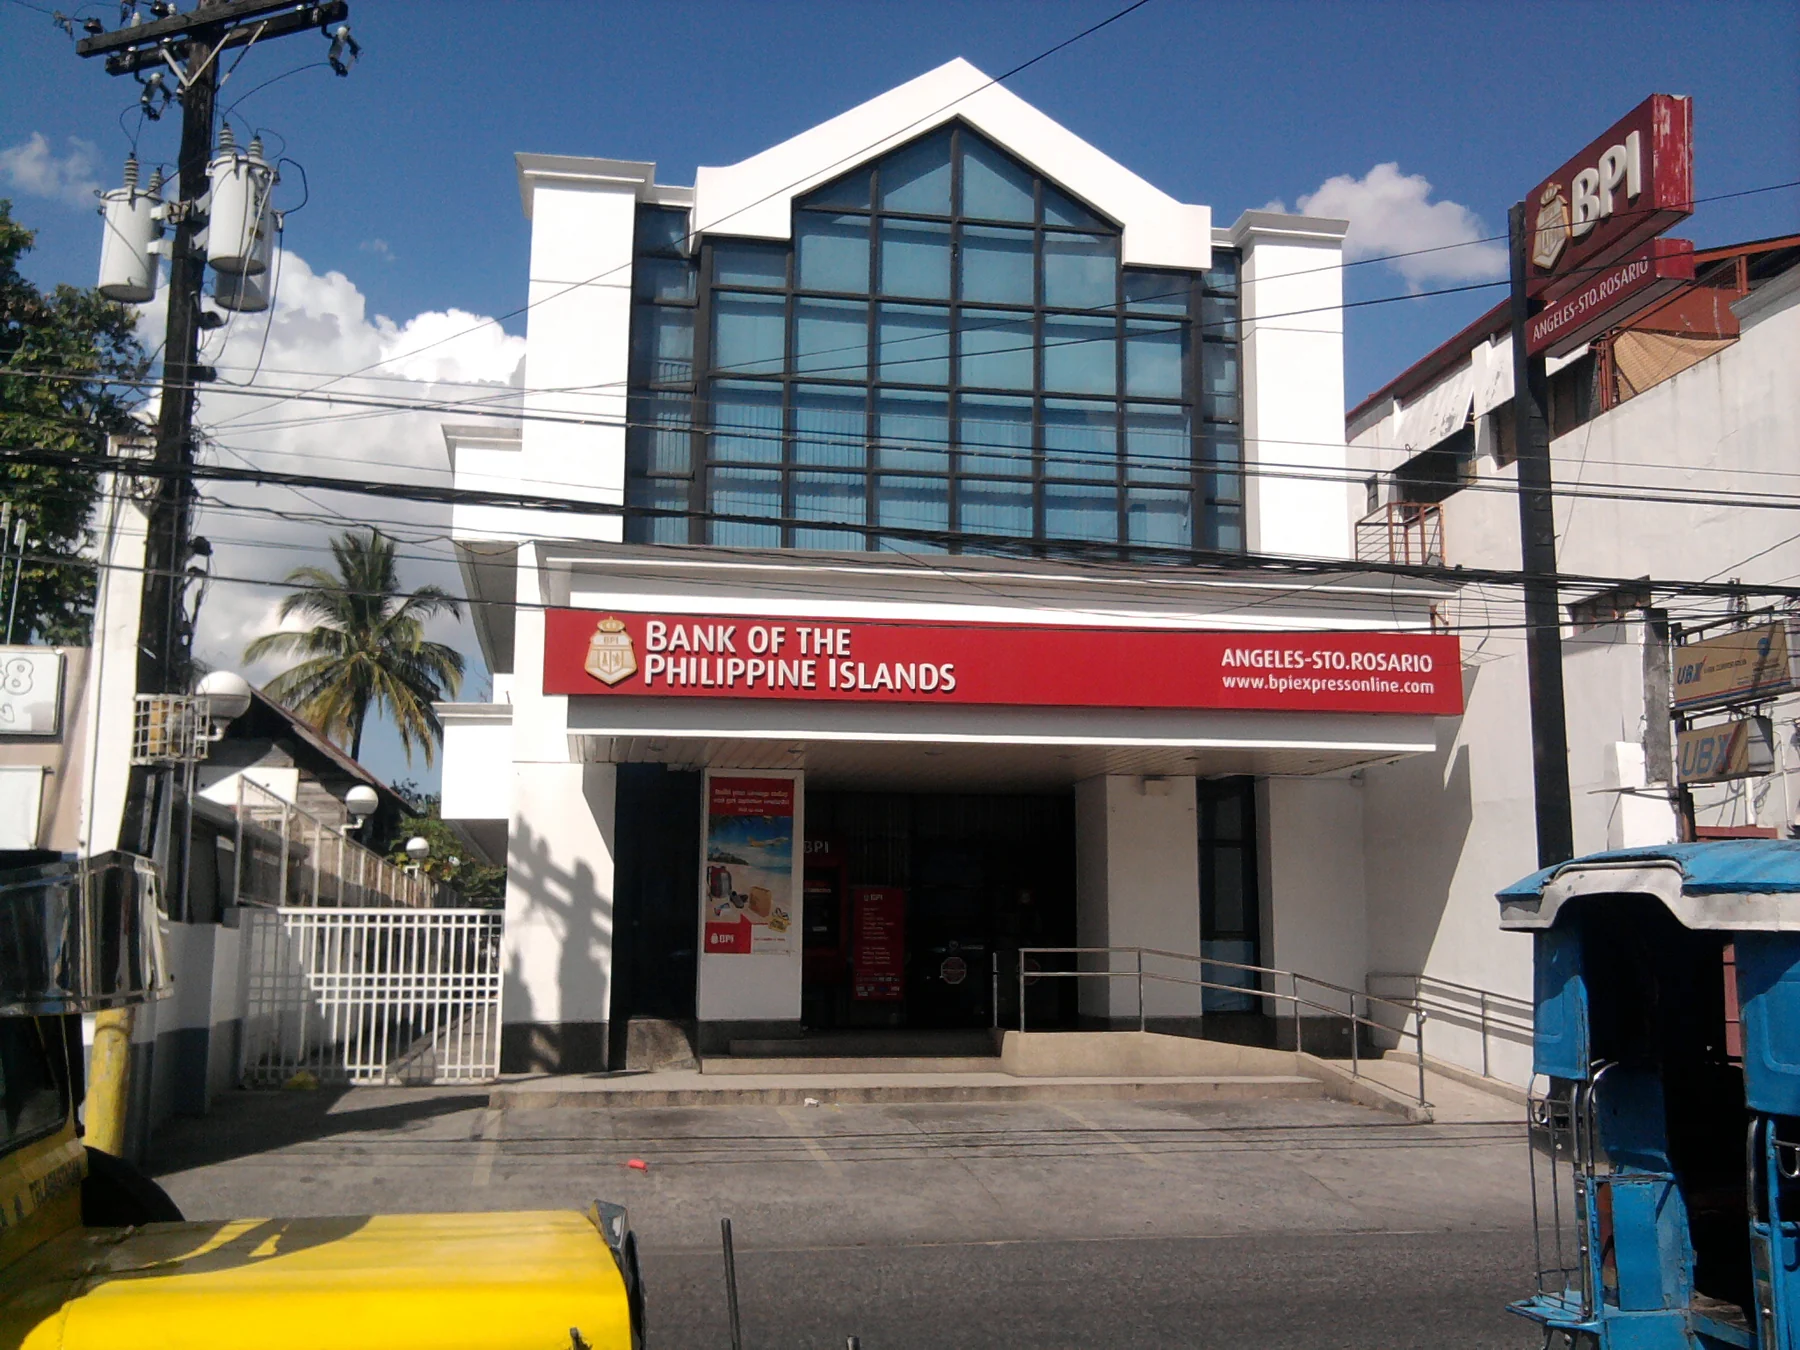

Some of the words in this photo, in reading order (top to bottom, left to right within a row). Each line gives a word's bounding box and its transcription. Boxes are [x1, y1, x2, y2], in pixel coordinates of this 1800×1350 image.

[1571, 130, 1641, 238] BPI
[1532, 256, 1649, 343] ANGELES-STO.ROSARIO
[644, 620, 737, 654] BANK
[746, 624, 787, 655] OF
[796, 626, 851, 657] THE
[643, 653, 816, 688] PHILIPPINE
[828, 658, 957, 692] ISLANDS
[1221, 648, 1433, 673] ANGELES-STO.ROSARIO
[1221, 673, 1435, 695] www.bpiexpressonline.com
